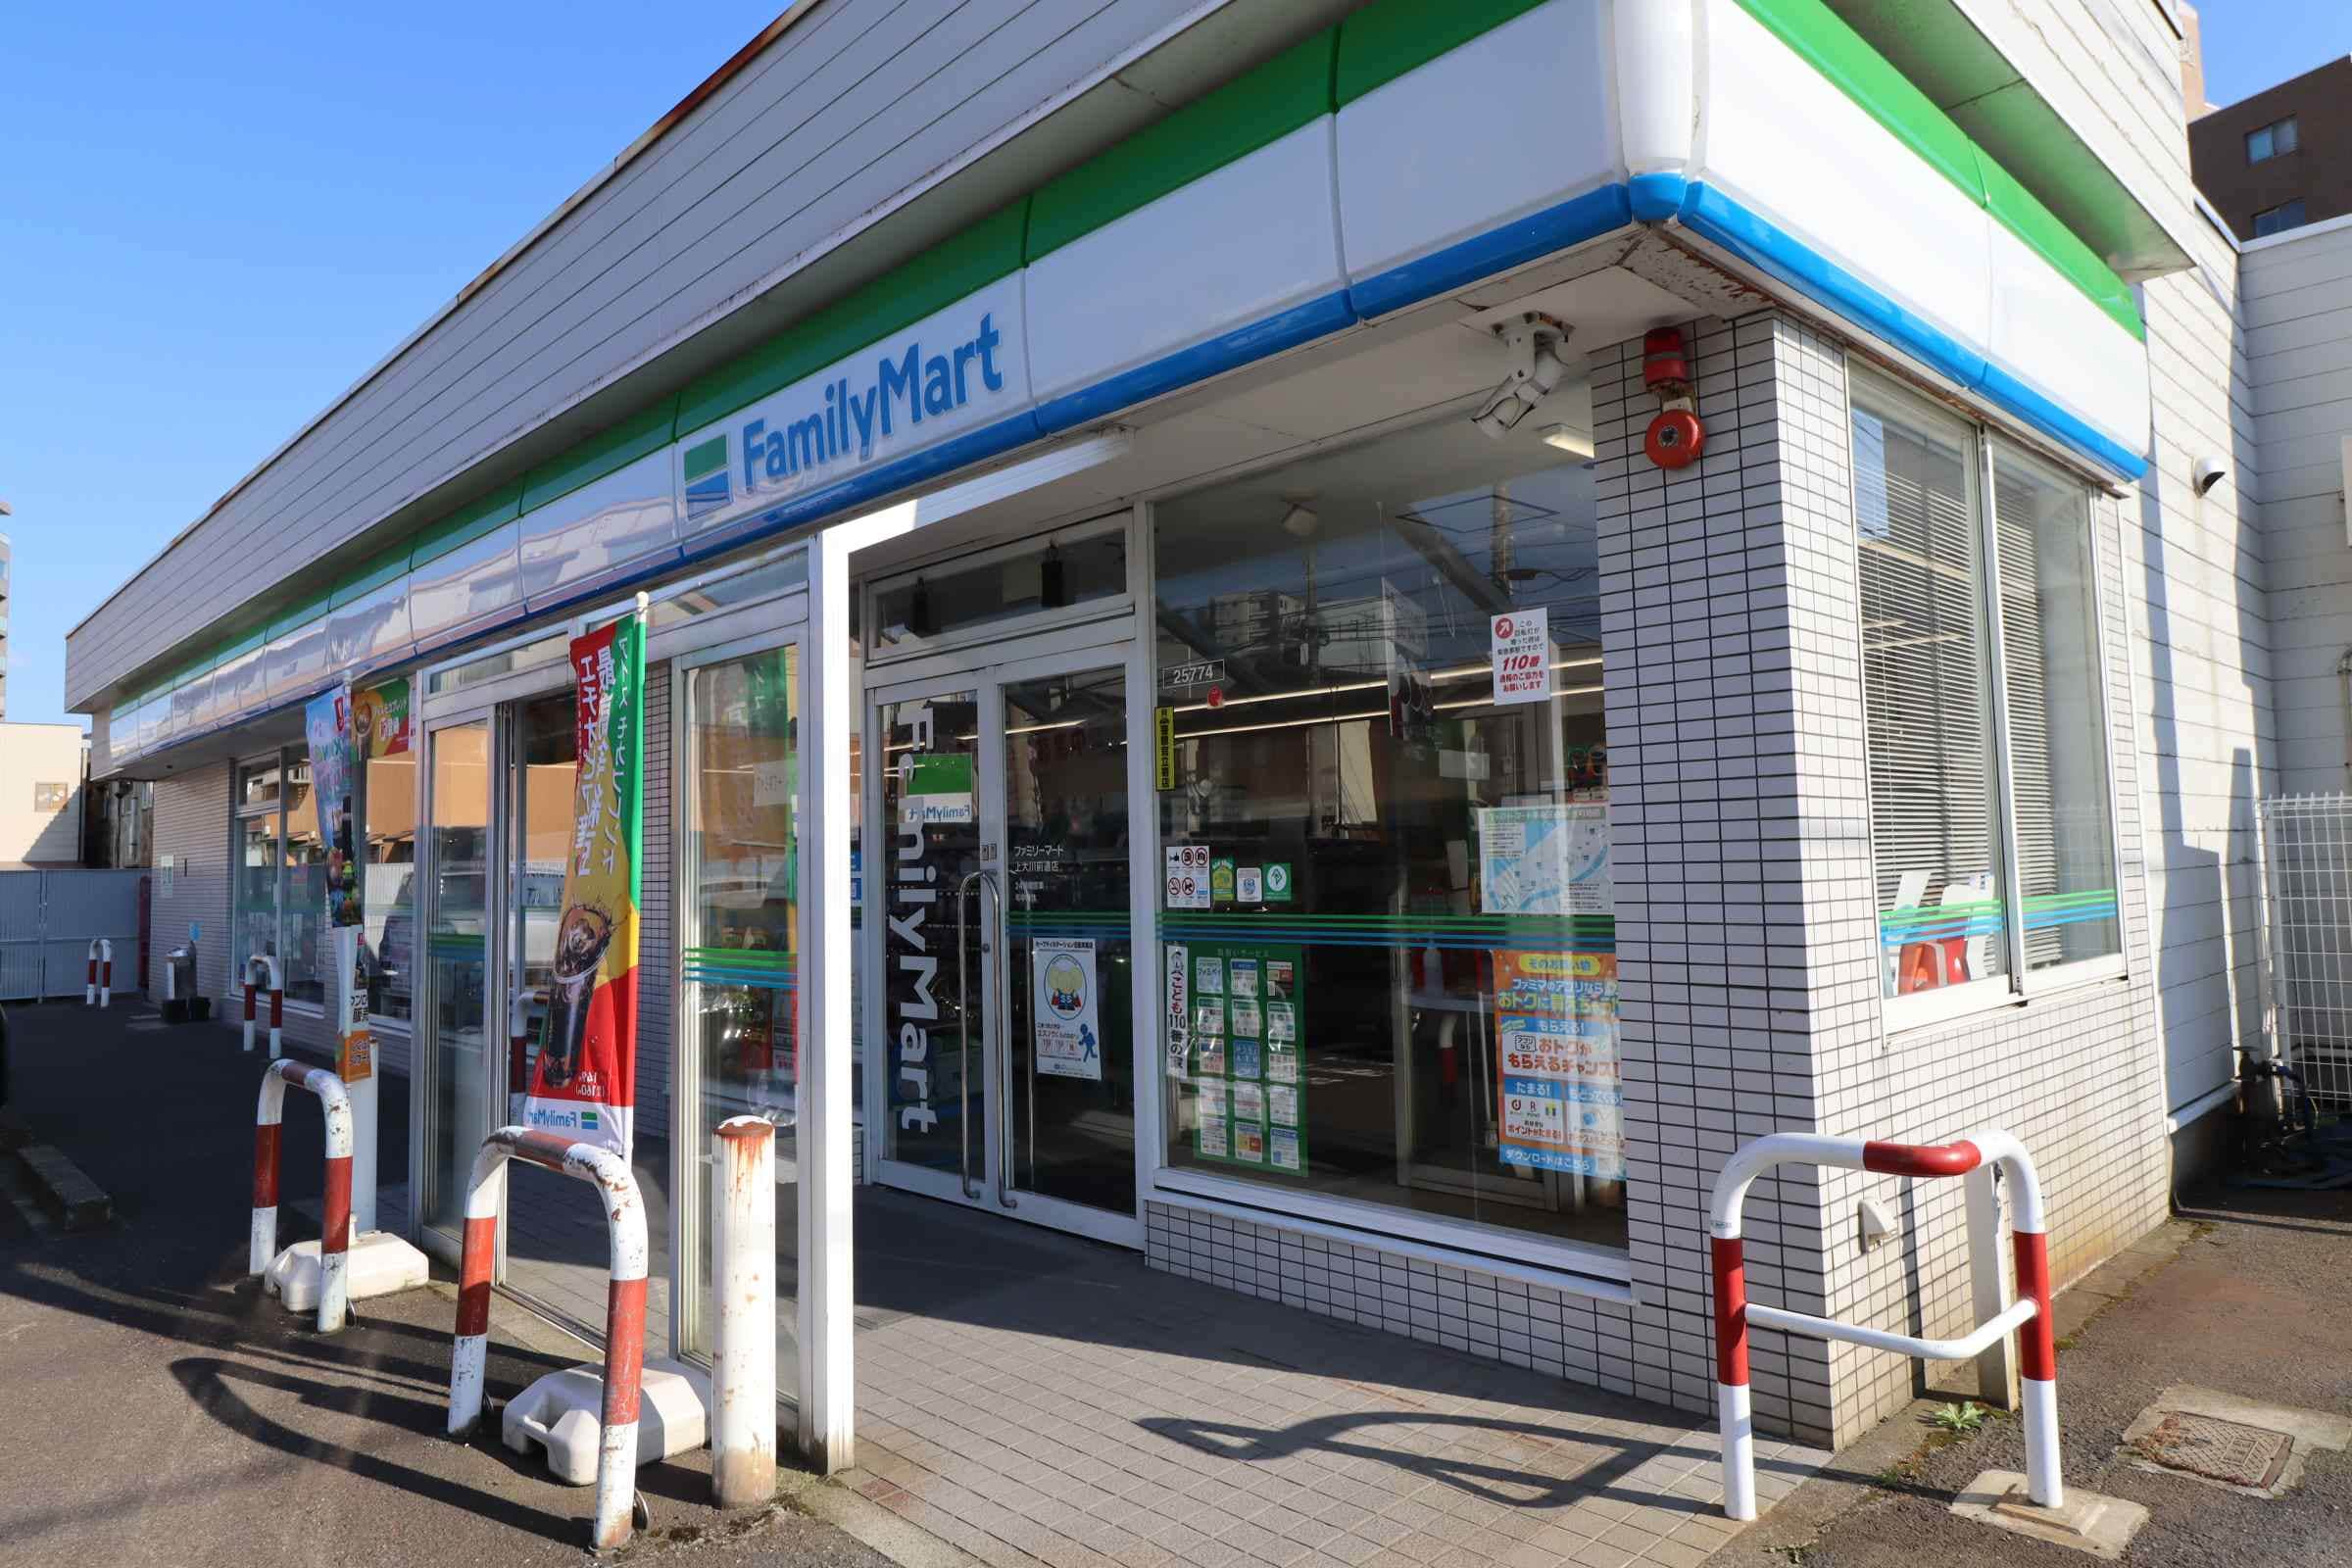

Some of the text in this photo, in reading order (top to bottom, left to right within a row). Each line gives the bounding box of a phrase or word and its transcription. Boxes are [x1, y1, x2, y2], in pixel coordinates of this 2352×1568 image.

[743, 313, 1004, 494] FamilyMart
[1502, 655, 1541, 671] 110番
[1173, 664, 1213, 684] 25774
[1013, 845, 1064, 858] ファミリーマート
[889, 702, 938, 1133] FamilyMart
